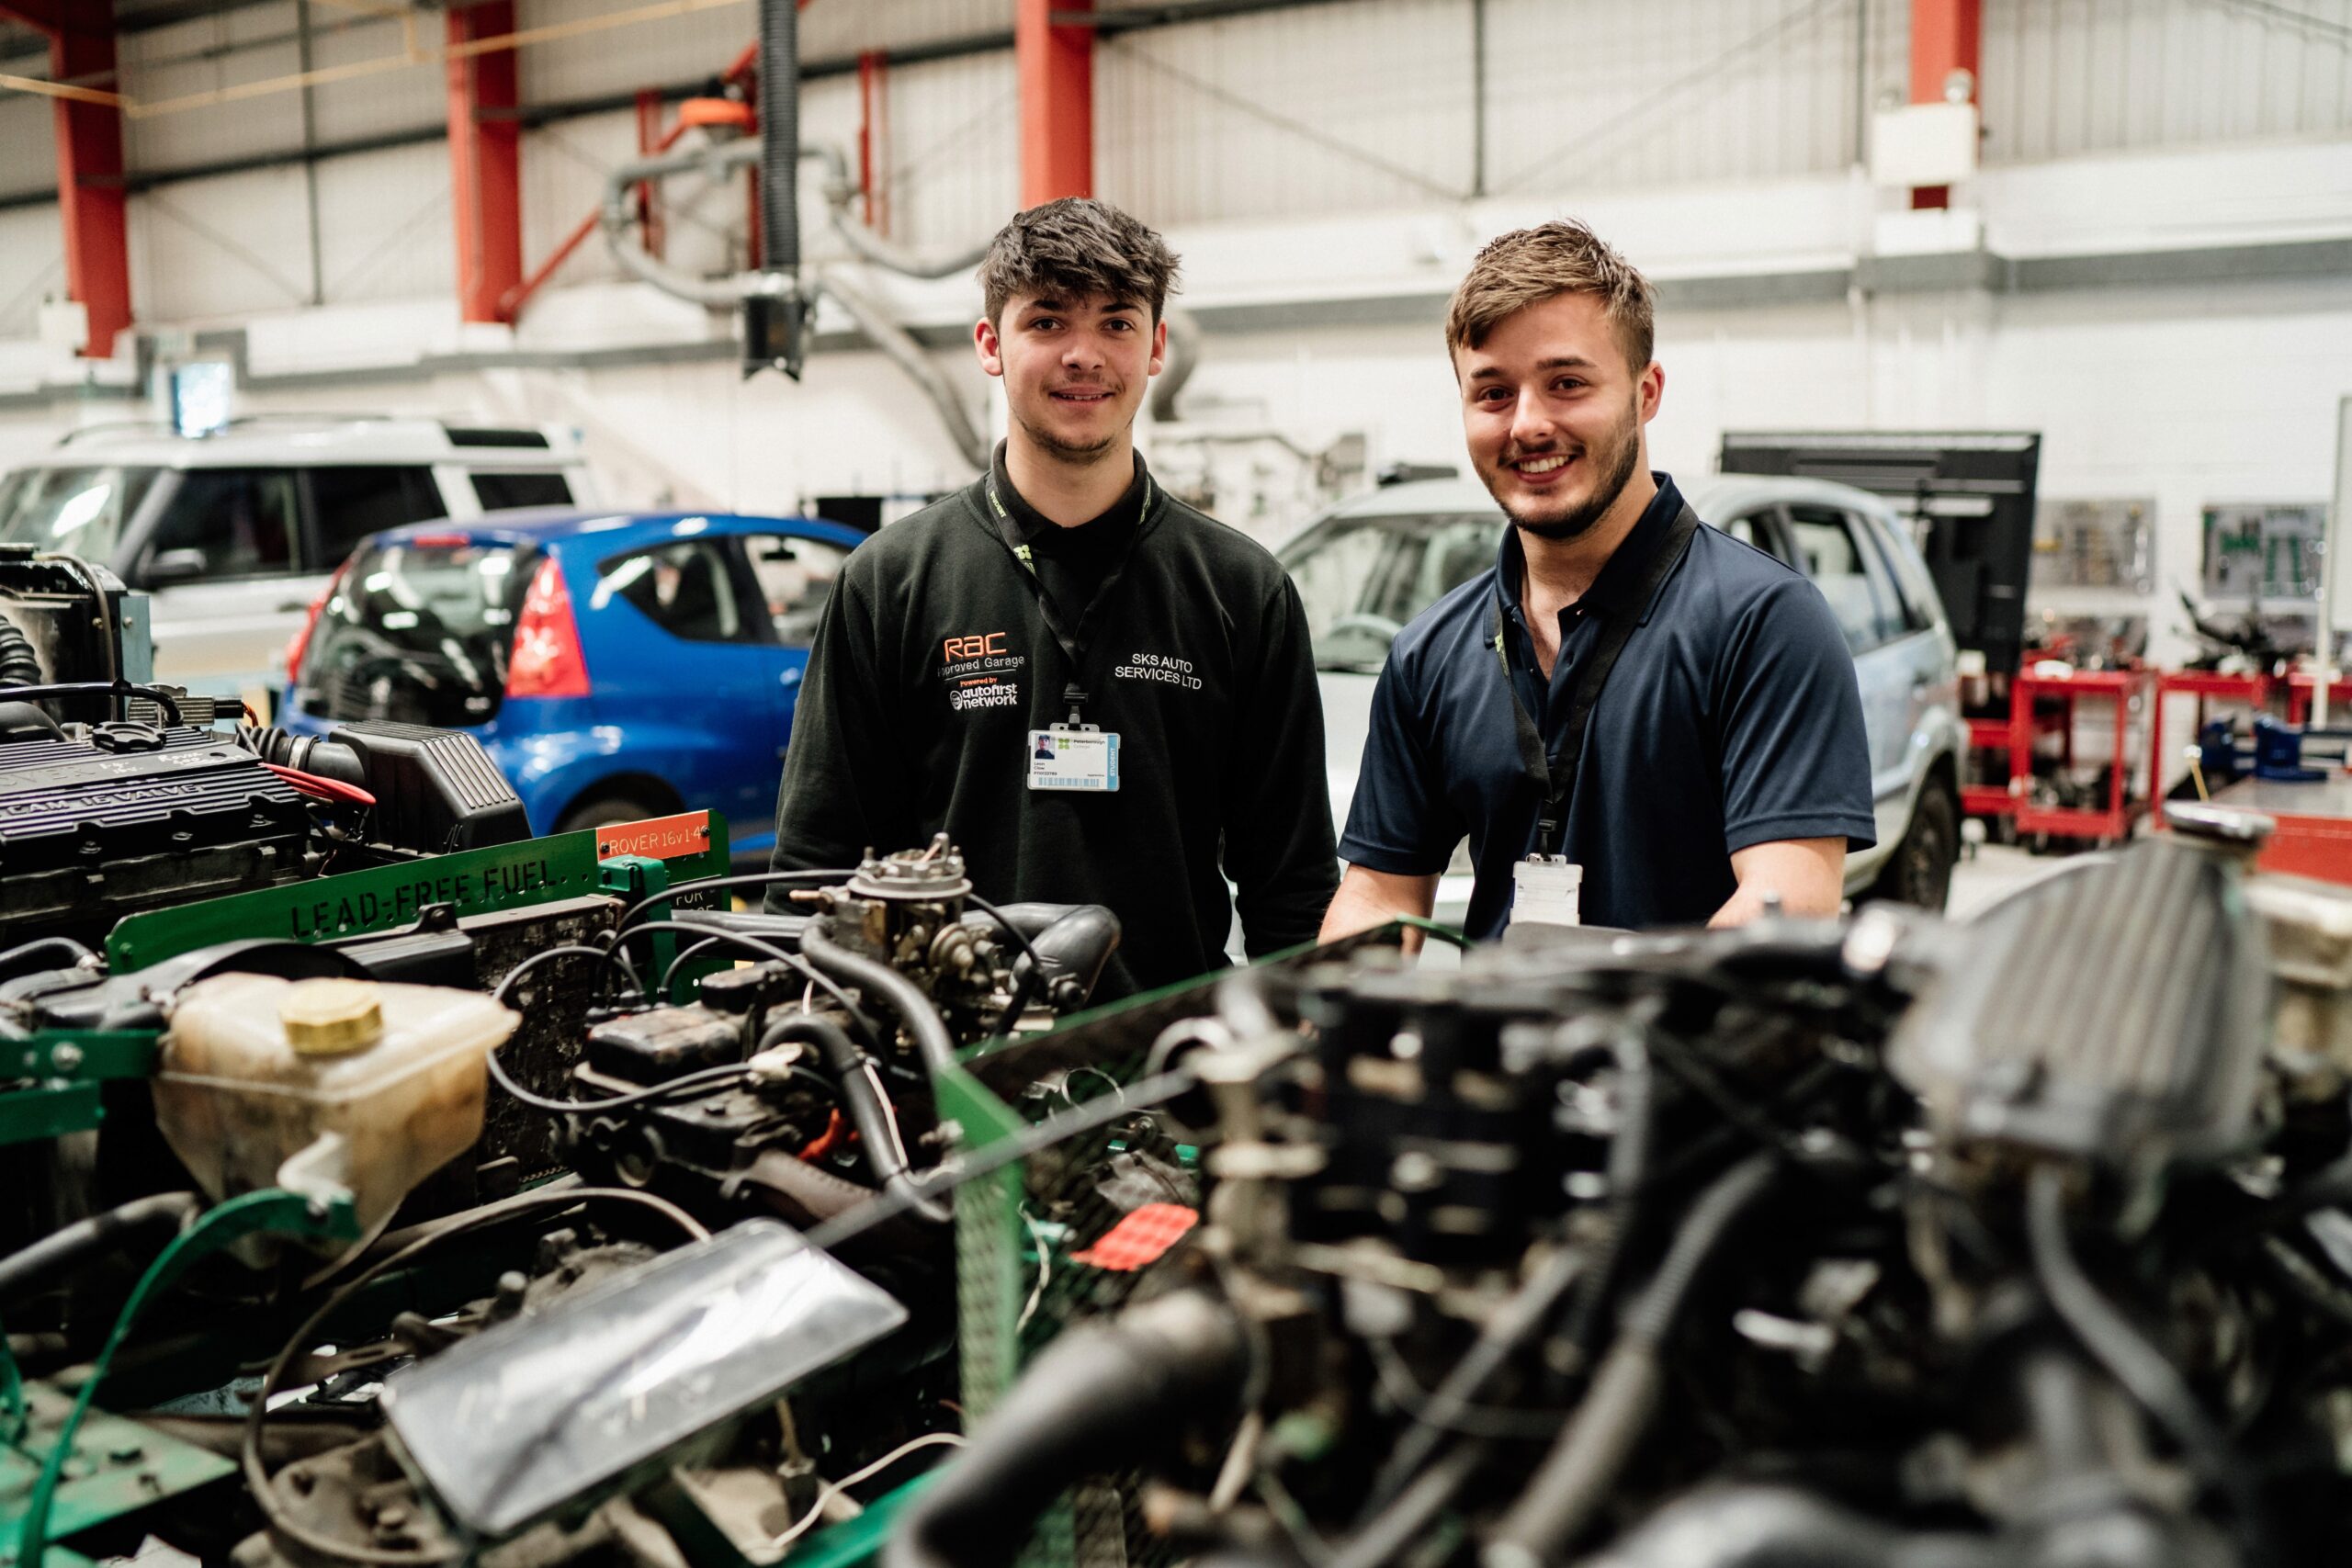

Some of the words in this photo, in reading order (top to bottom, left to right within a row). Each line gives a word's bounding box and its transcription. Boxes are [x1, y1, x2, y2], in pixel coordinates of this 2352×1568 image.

[984, 656, 1025, 669] Garage
[1131, 653, 1159, 666] SKS
[1160, 656, 1193, 673] AUTO
[1114, 666, 1181, 684] SERVICES
[1182, 675, 1203, 690] LTD
[961, 682, 1018, 699] autofirst
[963, 694, 1018, 710] network
[6, 799, 71, 817] CAM
[608, 832, 660, 855] ROVER
[662, 829, 684, 847] 16v
[483, 860, 557, 898] FUEL
